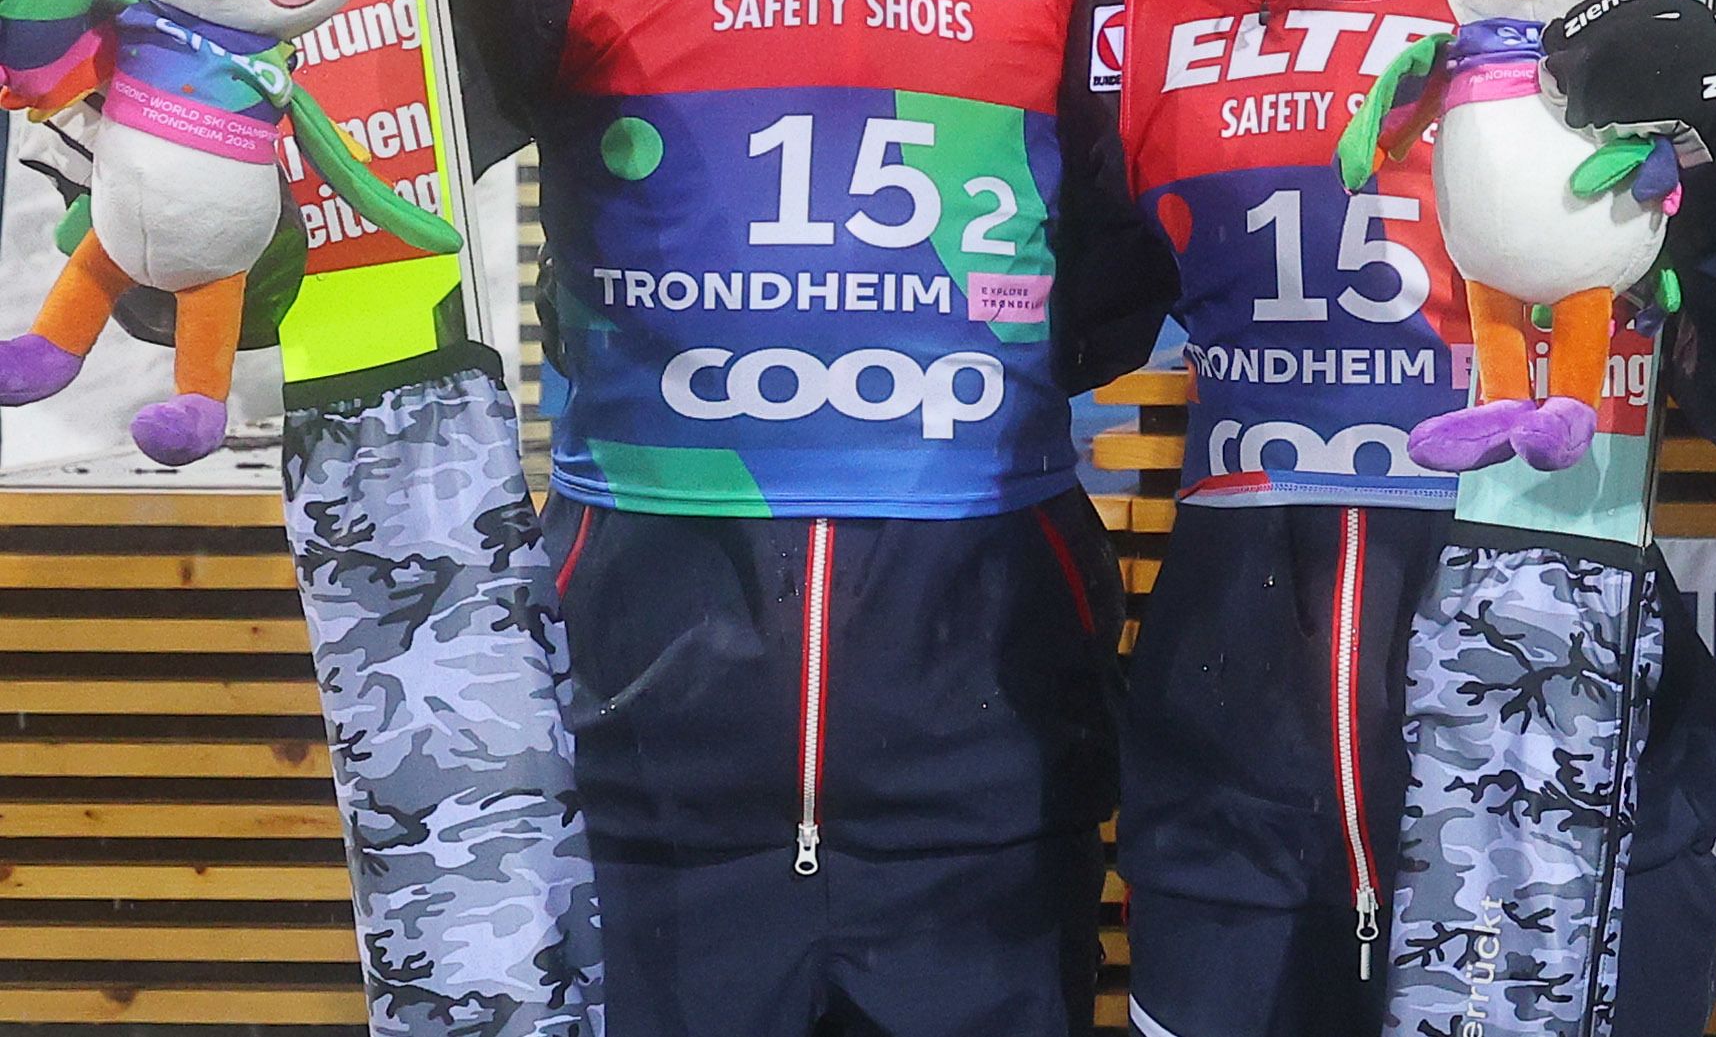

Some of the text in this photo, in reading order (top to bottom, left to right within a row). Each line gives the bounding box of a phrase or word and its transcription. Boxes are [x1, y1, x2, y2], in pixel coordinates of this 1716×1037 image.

[1161, 9, 1457, 94] ELTE
[142, 107, 257, 151] TRONDHEIM 2025
[150, 96, 201, 121] WORLD
[203, 113, 226, 129] SKI
[1221, 91, 1335, 139] SAFETY
[747, 114, 1019, 256] 15 2
[1244, 189, 1431, 324] 15
[593, 267, 952, 314] TRONDHEIM
[981, 286, 1029, 296] EXPLORE
[660, 347, 1006, 440] coop
[1209, 419, 1458, 477] coo
[1463, 895, 1504, 1037] errückt
